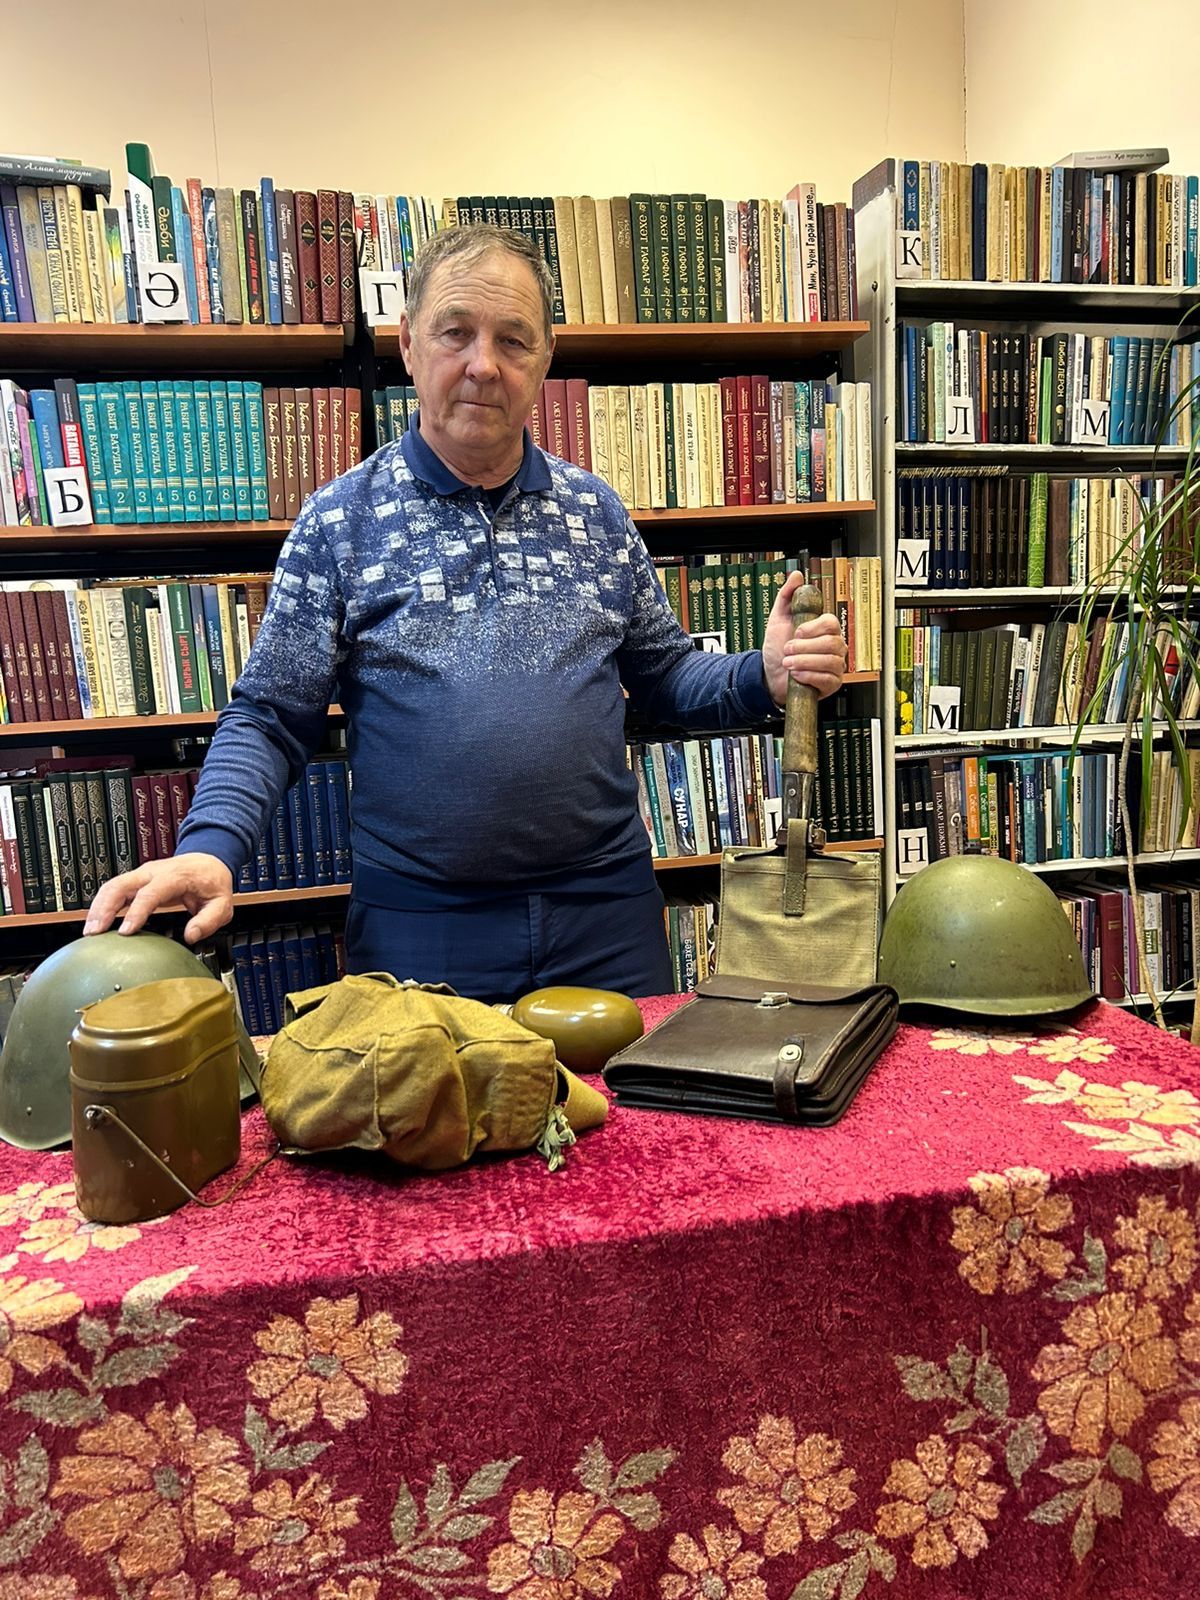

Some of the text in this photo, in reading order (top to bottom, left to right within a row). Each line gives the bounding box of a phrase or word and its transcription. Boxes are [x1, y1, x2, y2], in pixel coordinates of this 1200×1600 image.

[41, 198, 55, 224] КЫЗЫ
[158, 207, 173, 248] Әдәби
[44, 226, 59, 249] ИДЕЛ
[900, 237, 921, 266] К
[639, 214, 650, 307] ӘХӘТ ГАФФАР 1
[660, 215, 670, 306] ӘХӘТ ГАФФАР 2
[677, 214, 687, 306] ӘХӘТ ГАФФАР 3
[695, 214, 705, 305] ӘХӘТ ГАФФАР 4
[807, 249, 817, 269] Чуен
[145, 272, 179, 308] Ә
[371, 282, 397, 316] Г
[268, 403, 277, 432] Рабит
[333, 399, 342, 431] Рабит
[349, 411, 359, 442] Рабит
[948, 407, 970, 435] Л
[1081, 409, 1108, 437] М
[64, 424, 81, 466] ВАТАНГА
[84, 404, 104, 505] РАБИТ БАТУЛЛА 1
[106, 403, 126, 504] РАБИТ БАТУЛЛА 2
[129, 402, 147, 503] РАБИТ БАТУЛЛА 3
[146, 402, 164, 503] РАБИТ БАТУЛЛА 4
[163, 401, 179, 501] РАБИТ БАТУЛЛА 5
[180, 401, 197, 502] РАБИТ БАТУЛЛА 6
[199, 401, 214, 501] РАБИТ БАТУЛЛА 7
[215, 400, 230, 500] РАБИТ БАТУЛЛА 8
[232, 402, 247, 501] РАБИТ БАТУЛЛА 9
[249, 401, 266, 501] РАБИТ БАТУЛЛА 10
[268, 435, 280, 479] Батулла
[283, 402, 296, 502] Рабит Батулла 2
[298, 402, 311, 478] Рабит Батулла
[316, 399, 327, 480] Рабит Батулла
[54, 479, 84, 514] Б
[897, 551, 929, 578] М
[936, 569, 943, 579] 8
[949, 569, 956, 579] 9
[959, 570, 969, 580] 10
[928, 704, 958, 730] М
[674, 788, 688, 828] СУНАР
[901, 836, 926, 863] Н
[684, 939, 693, 976] БӘХЕТСЕЗ
